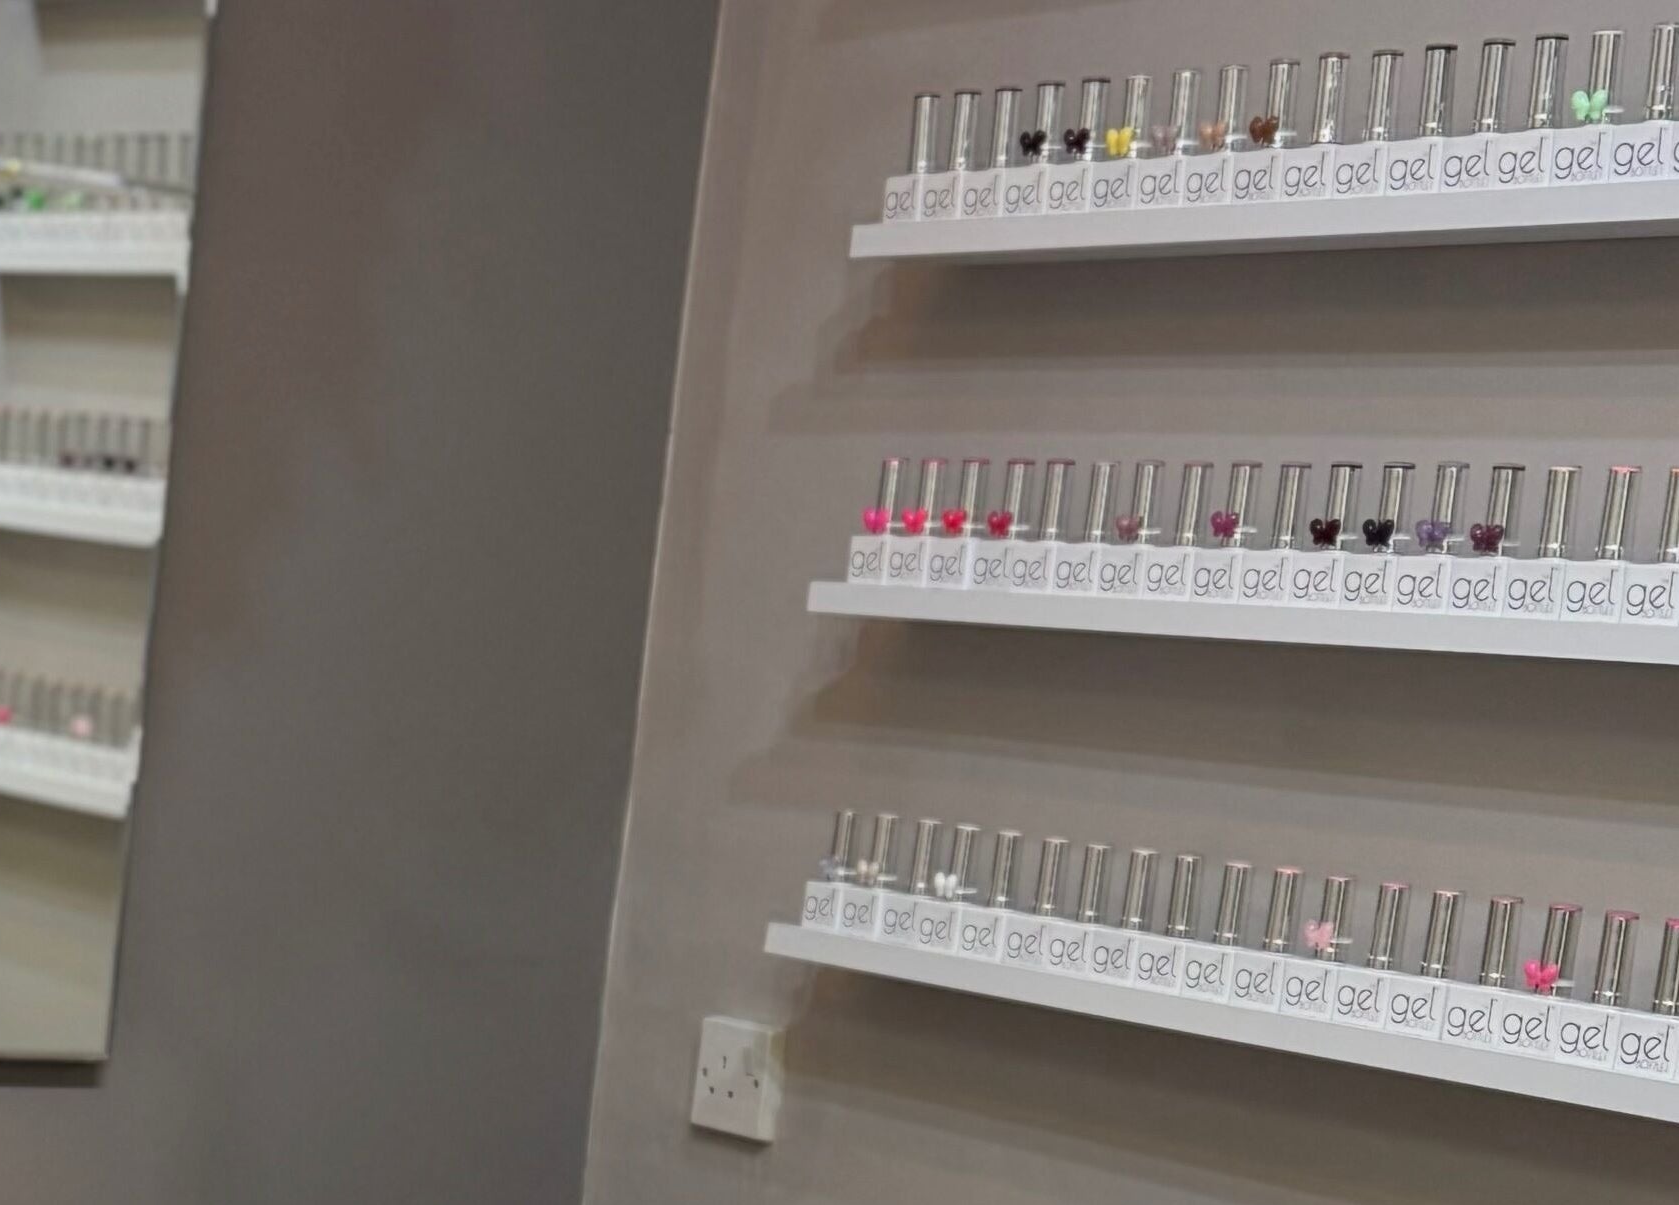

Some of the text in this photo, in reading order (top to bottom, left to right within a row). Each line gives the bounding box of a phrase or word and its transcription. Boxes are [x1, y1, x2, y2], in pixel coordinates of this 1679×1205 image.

[1335, 149, 1378, 195] gel
[1389, 144, 1435, 191] gel
[1443, 140, 1490, 187] gel
[1498, 136, 1545, 184] gel
[1554, 132, 1603, 180] gel
[1613, 127, 1664, 176] gel
[1004, 168, 1041, 213] gel
[1049, 167, 1087, 209] gel
[1093, 164, 1132, 208] gel
[1140, 161, 1181, 205] gel
[1186, 159, 1226, 203] gel
[1234, 156, 1275, 200] gel
[1284, 149, 1326, 197] gel
[885, 178, 915, 219] gel
[923, 174, 956, 218] gel
[963, 171, 999, 217] gel
[851, 541, 884, 577] gel
[889, 543, 923, 577] gel
[929, 544, 964, 582] gel
[973, 547, 1011, 585] gel
[1012, 548, 1048, 587] gel
[1056, 550, 1094, 589] gel
[1100, 552, 1139, 592] gel
[1147, 553, 1188, 592] gel
[1193, 554, 1235, 597] gel
[1242, 557, 1286, 600] gel
[1293, 558, 1337, 599] gel
[1344, 560, 1388, 601] gel
[1397, 562, 1442, 606] gel
[1452, 566, 1498, 609] gel
[1508, 567, 1555, 611] gel
[1566, 569, 1616, 613] gel
[1626, 571, 1677, 617] gel
[804, 888, 835, 921] gel
[842, 896, 874, 928] gel
[883, 902, 917, 935] gel
[920, 911, 955, 945] gel
[961, 917, 998, 951] gel
[1006, 925, 1044, 959] gel
[1049, 931, 1087, 966] gel
[1093, 938, 1131, 973] gel
[1138, 946, 1176, 980] gel
[1185, 953, 1225, 988] gel
[1234, 962, 1275, 998] gel
[1285, 970, 1328, 1006] gel
[1337, 977, 1380, 1015] gel
[1391, 986, 1436, 1024] gel
[1447, 998, 1494, 1036] gel
[1502, 1005, 1551, 1044] gel
[1560, 1014, 1609, 1054] gel
[1620, 1024, 1670, 1065] gel
